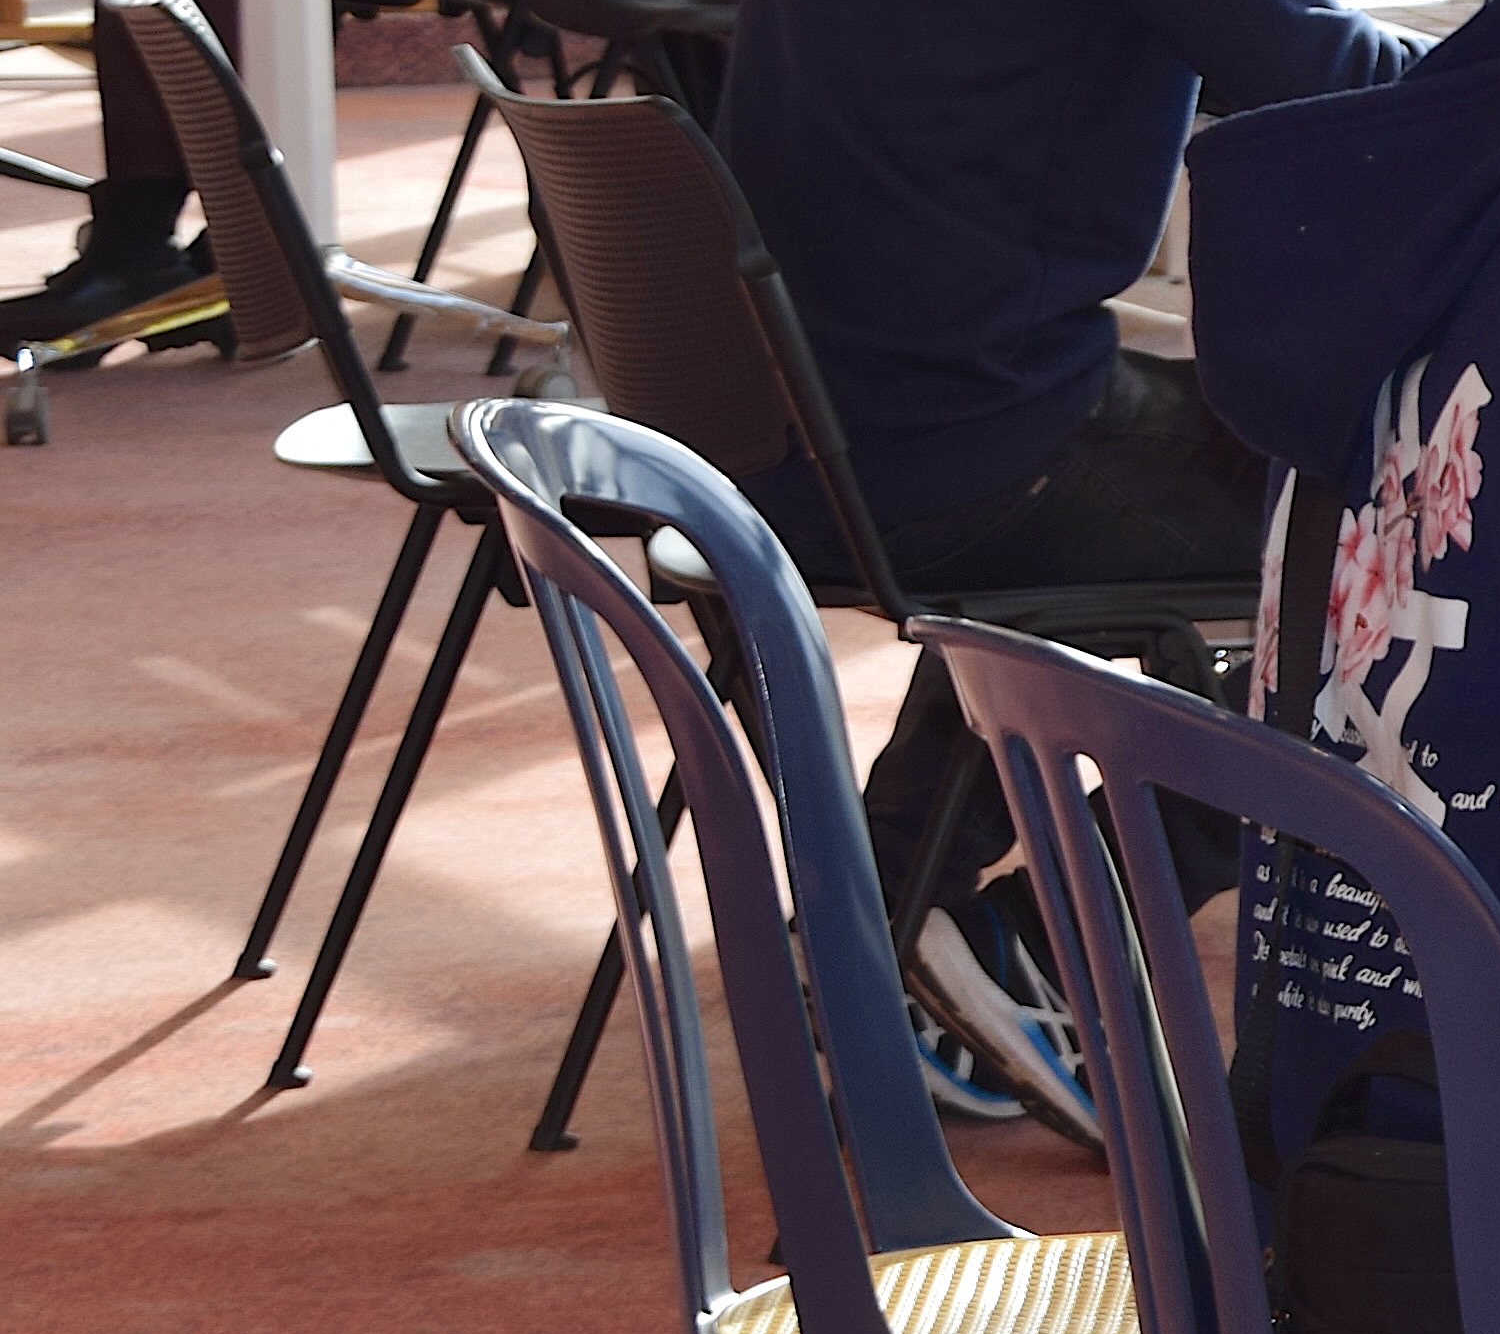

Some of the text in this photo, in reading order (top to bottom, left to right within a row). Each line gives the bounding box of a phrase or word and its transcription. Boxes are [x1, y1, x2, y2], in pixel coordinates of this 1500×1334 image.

[1451, 784, 1496, 810] and
[1323, 920, 1372, 943] used
[1369, 926, 1390, 949] to
[1355, 966, 1403, 989] and
